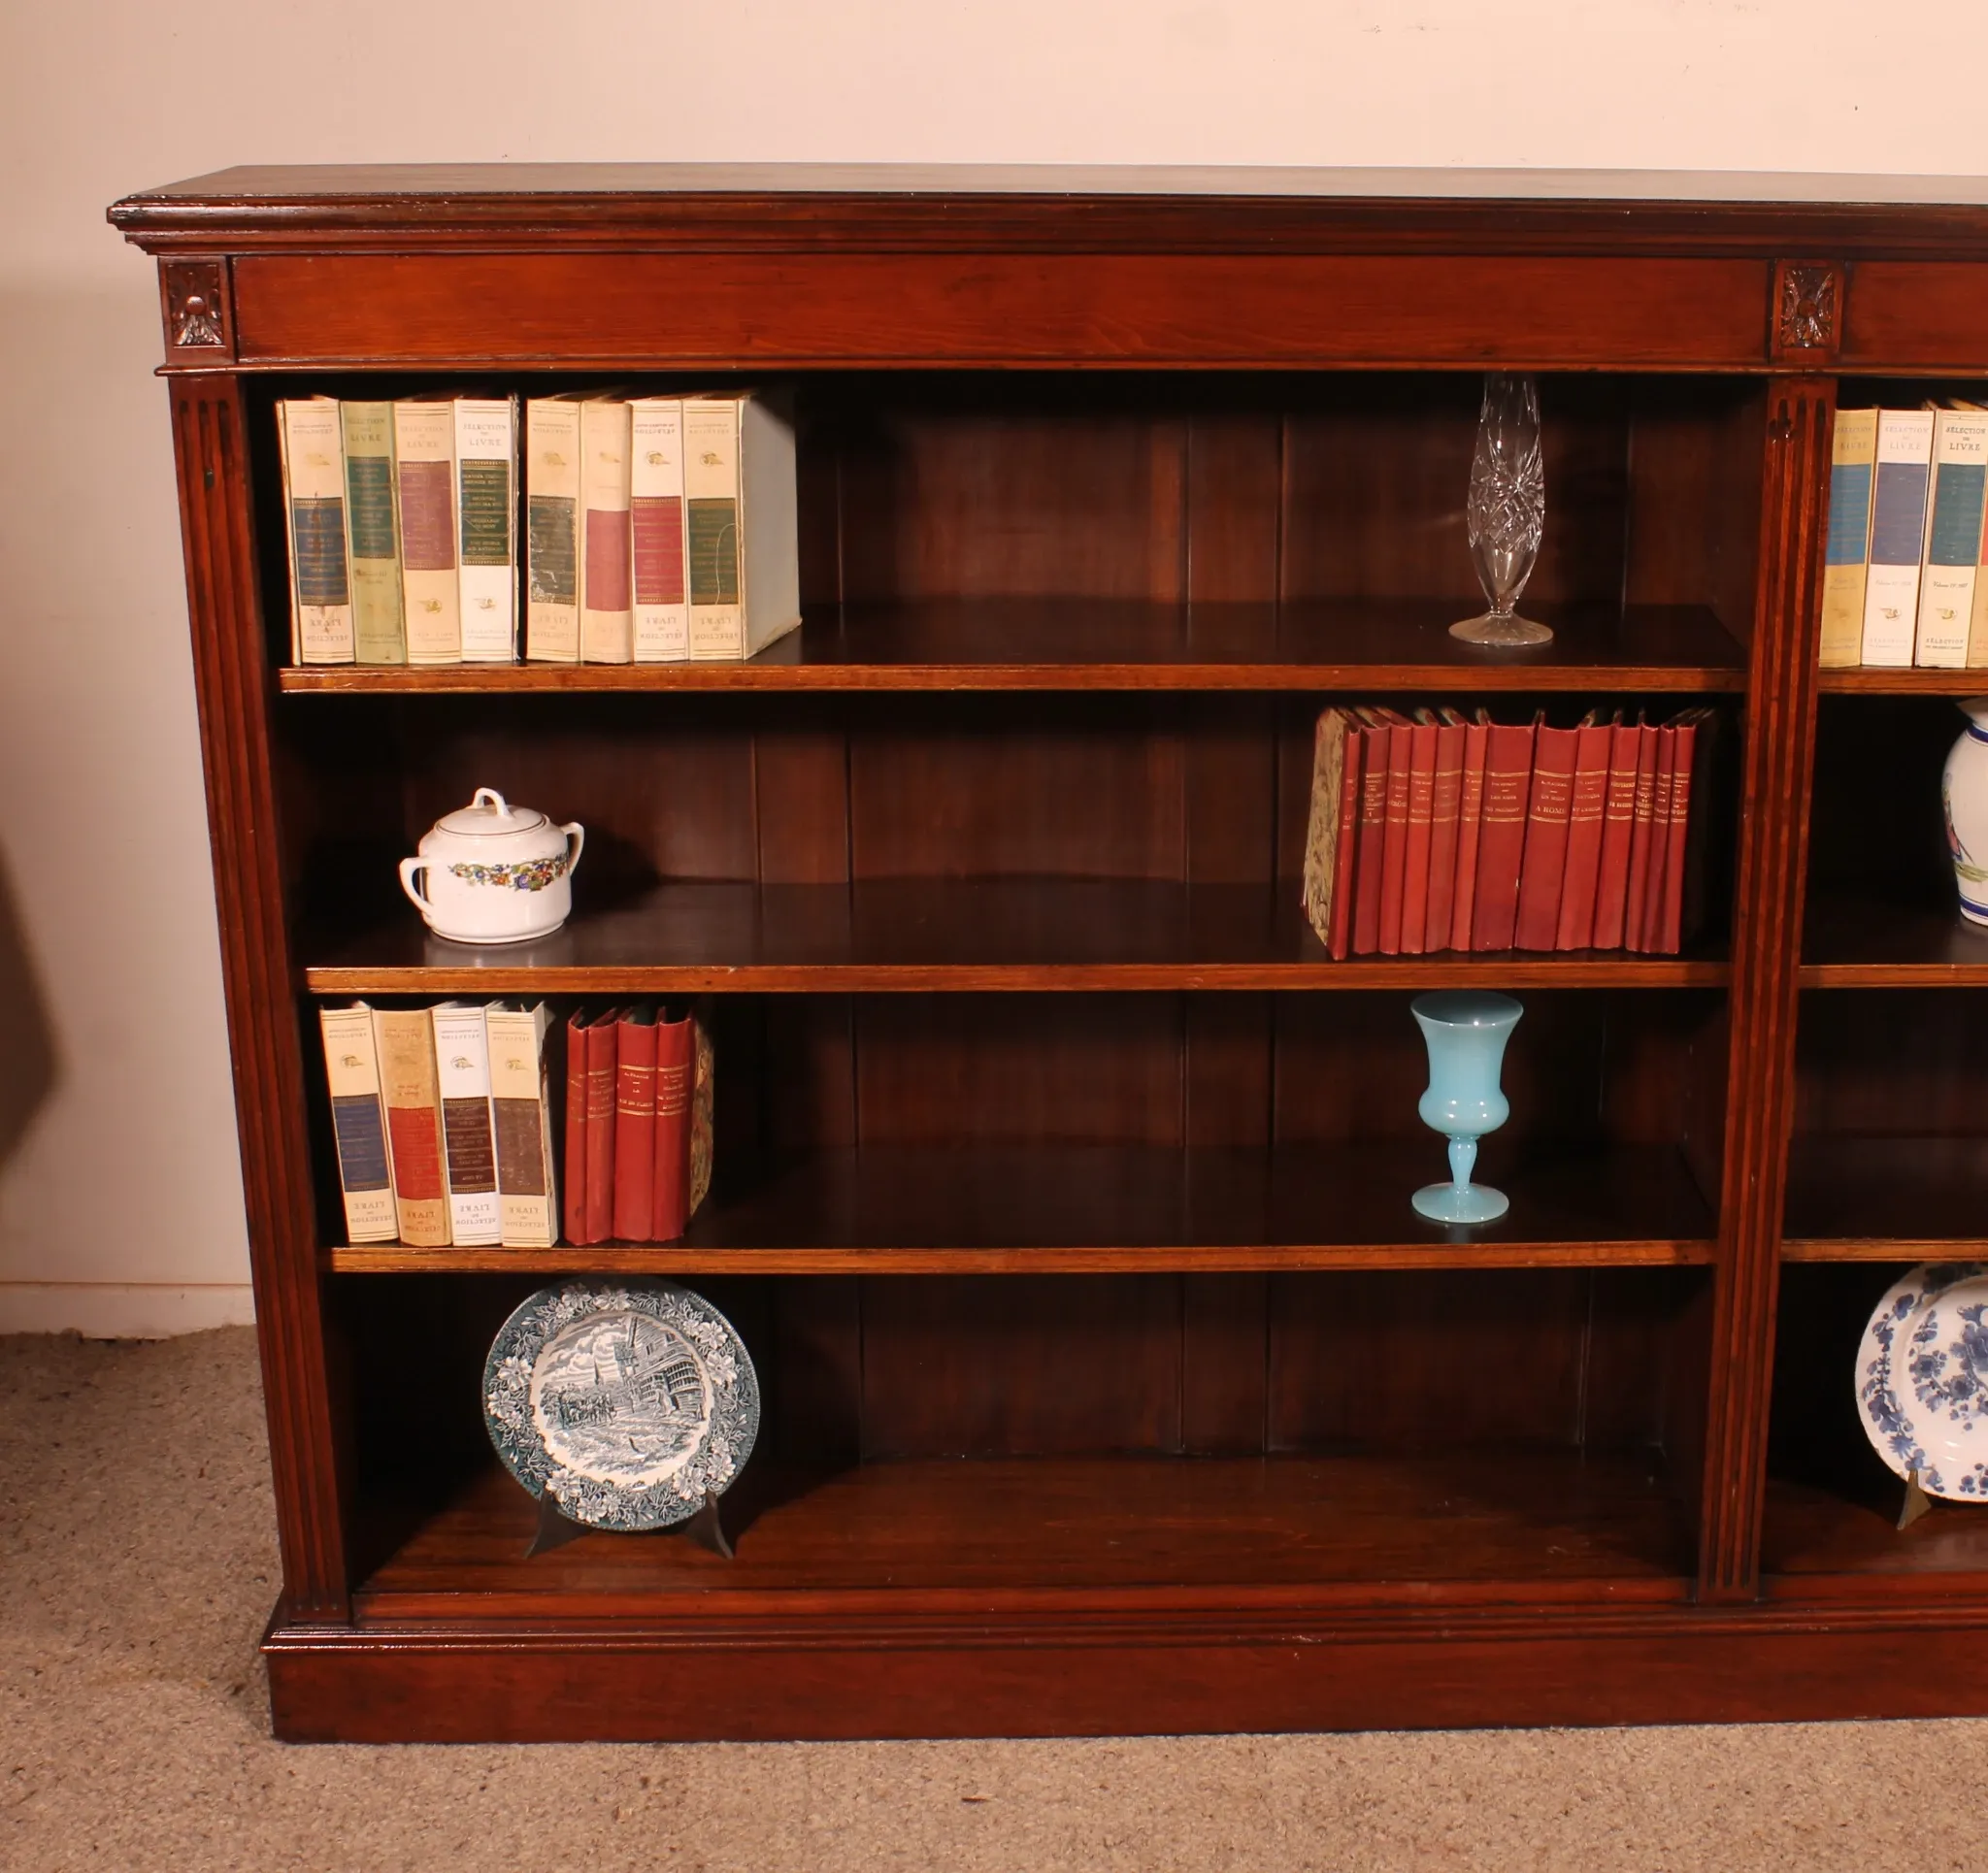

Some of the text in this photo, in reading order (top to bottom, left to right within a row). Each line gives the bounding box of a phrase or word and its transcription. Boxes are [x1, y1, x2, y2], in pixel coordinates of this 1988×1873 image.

[1889, 442, 1922, 450] LIVRE
[1948, 442, 1981, 451] LIVRE
[352, 1200, 385, 1210] LIVRE
[457, 1203, 490, 1213] LIVRE
[406, 1210, 434, 1219] LIVRE
